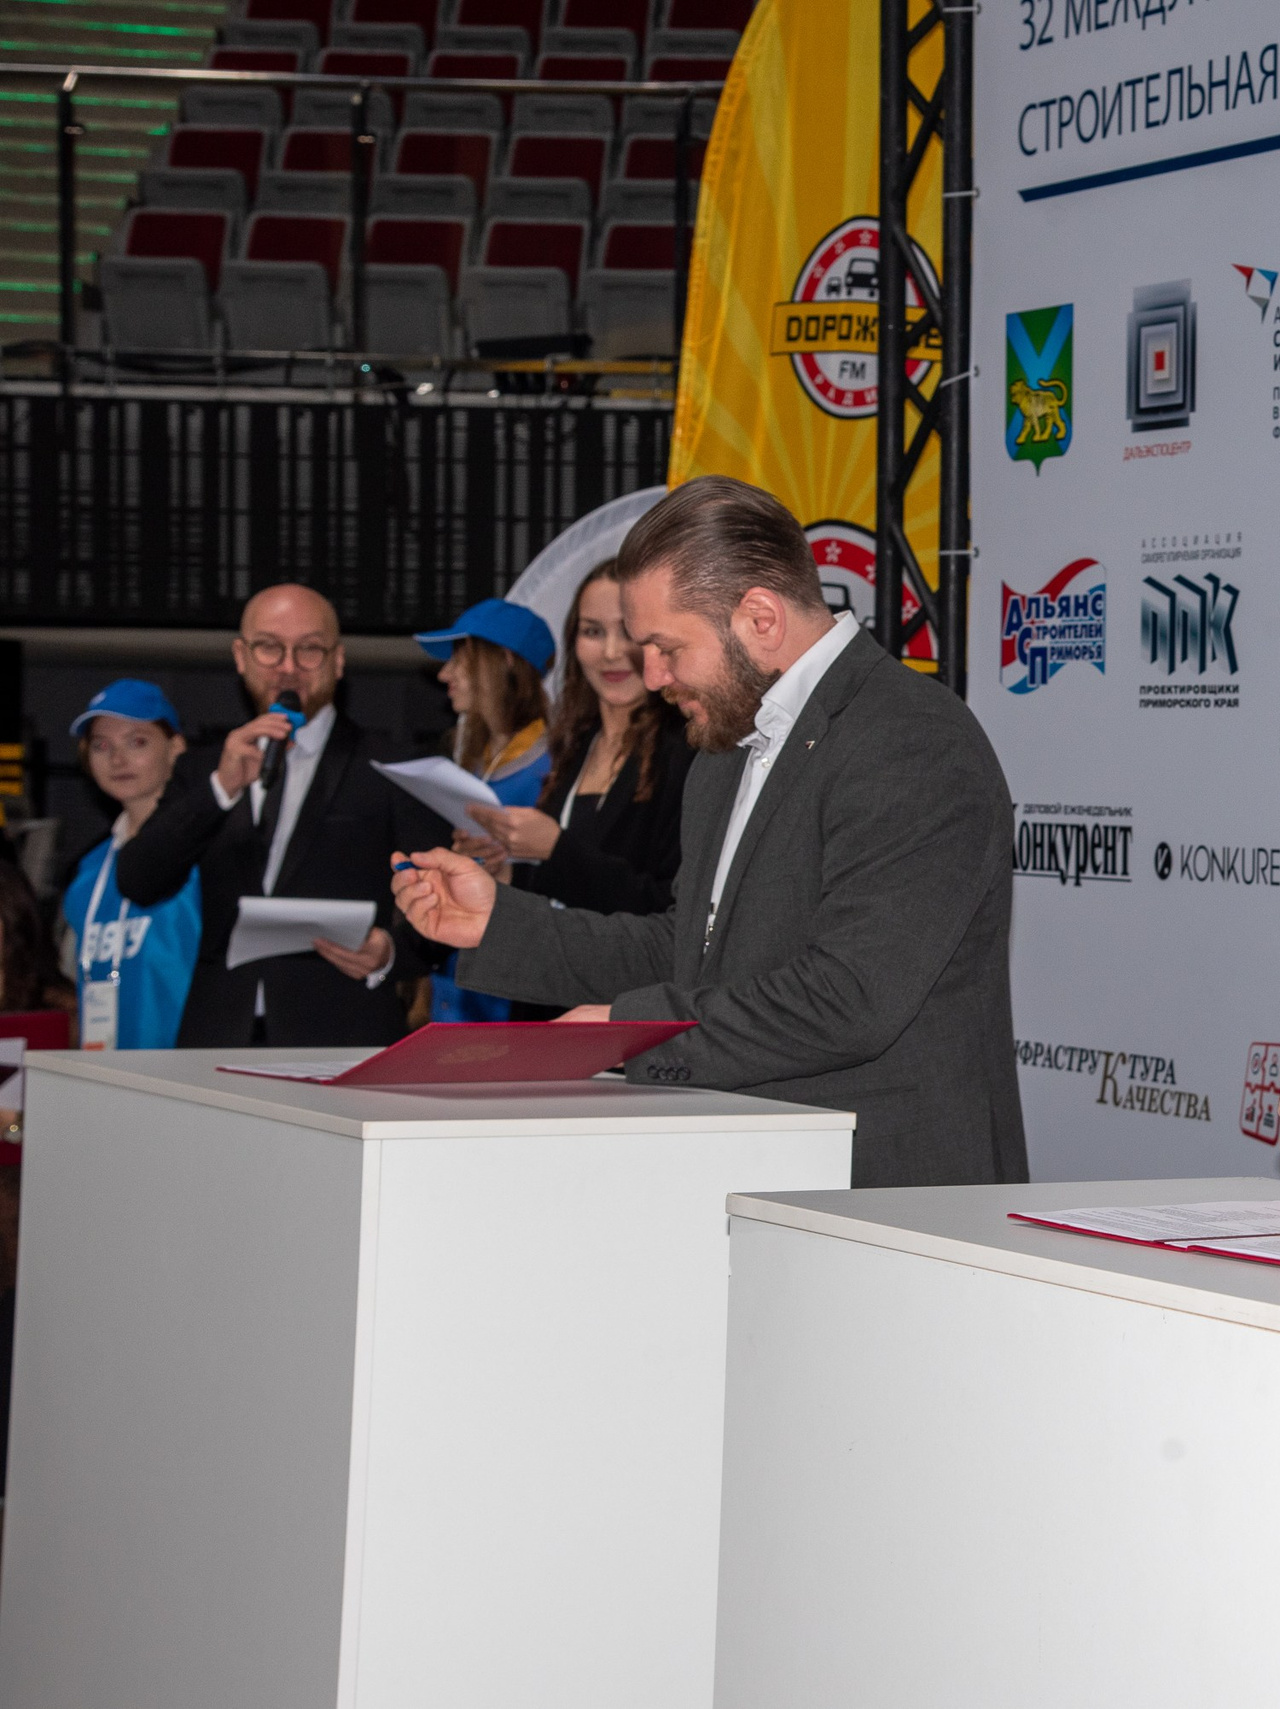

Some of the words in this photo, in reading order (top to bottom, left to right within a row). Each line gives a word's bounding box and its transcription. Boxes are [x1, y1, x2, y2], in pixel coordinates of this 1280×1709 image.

[1020, 0, 1054, 50] 32
[1018, 44, 1278, 156] СТРОИТЕЛЬНАЯ
[839, 359, 866, 380] FM
[1272, 406, 1280, 420] В
[1139, 684, 1239, 695] ПРОЕКТИРОВЩИКИ
[1139, 698, 1211, 708] ПРИМОРСКОГО
[1213, 698, 1239, 708] КРАЯ
[1064, 805, 1132, 817] ЕЖЕНЕДЕЛЬНИК
